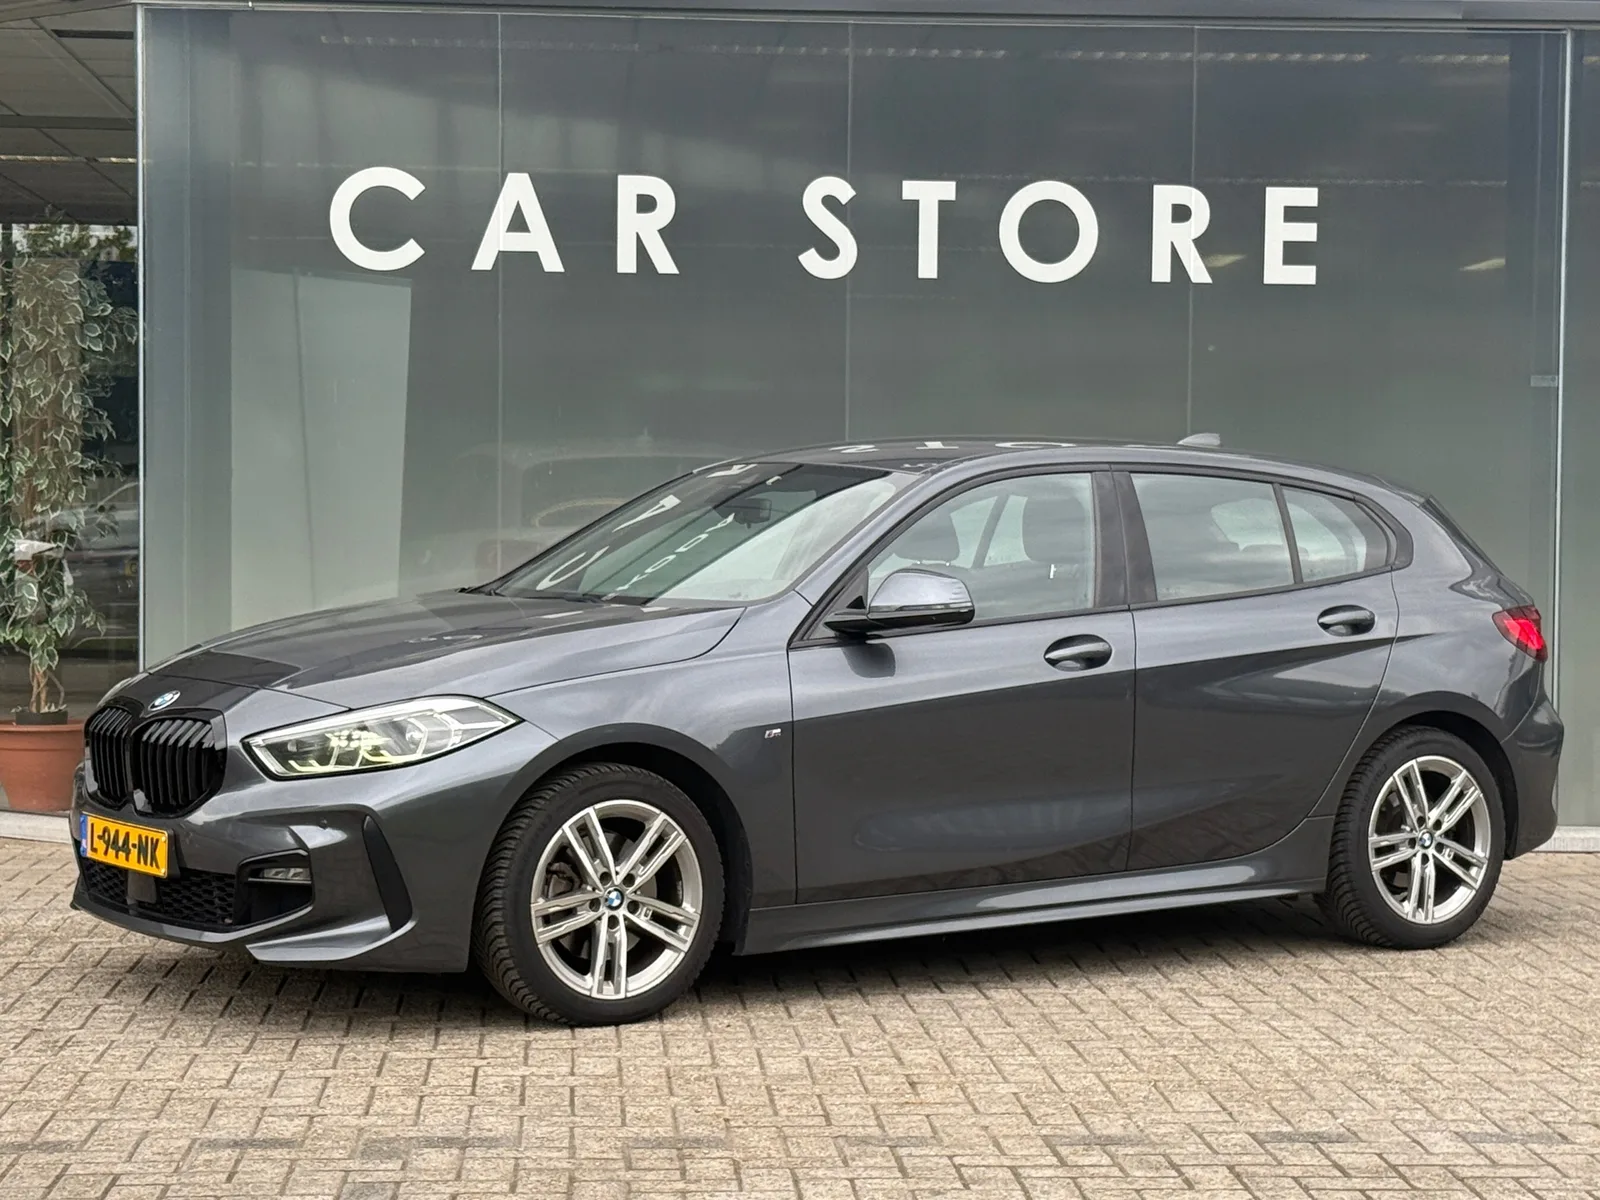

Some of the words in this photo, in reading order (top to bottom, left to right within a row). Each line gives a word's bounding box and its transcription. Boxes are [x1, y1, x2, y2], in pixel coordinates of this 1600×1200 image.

[329, 166, 680, 275] CAR
[797, 175, 1320, 285] STORE
[90, 822, 160, 869] L-944-NK
